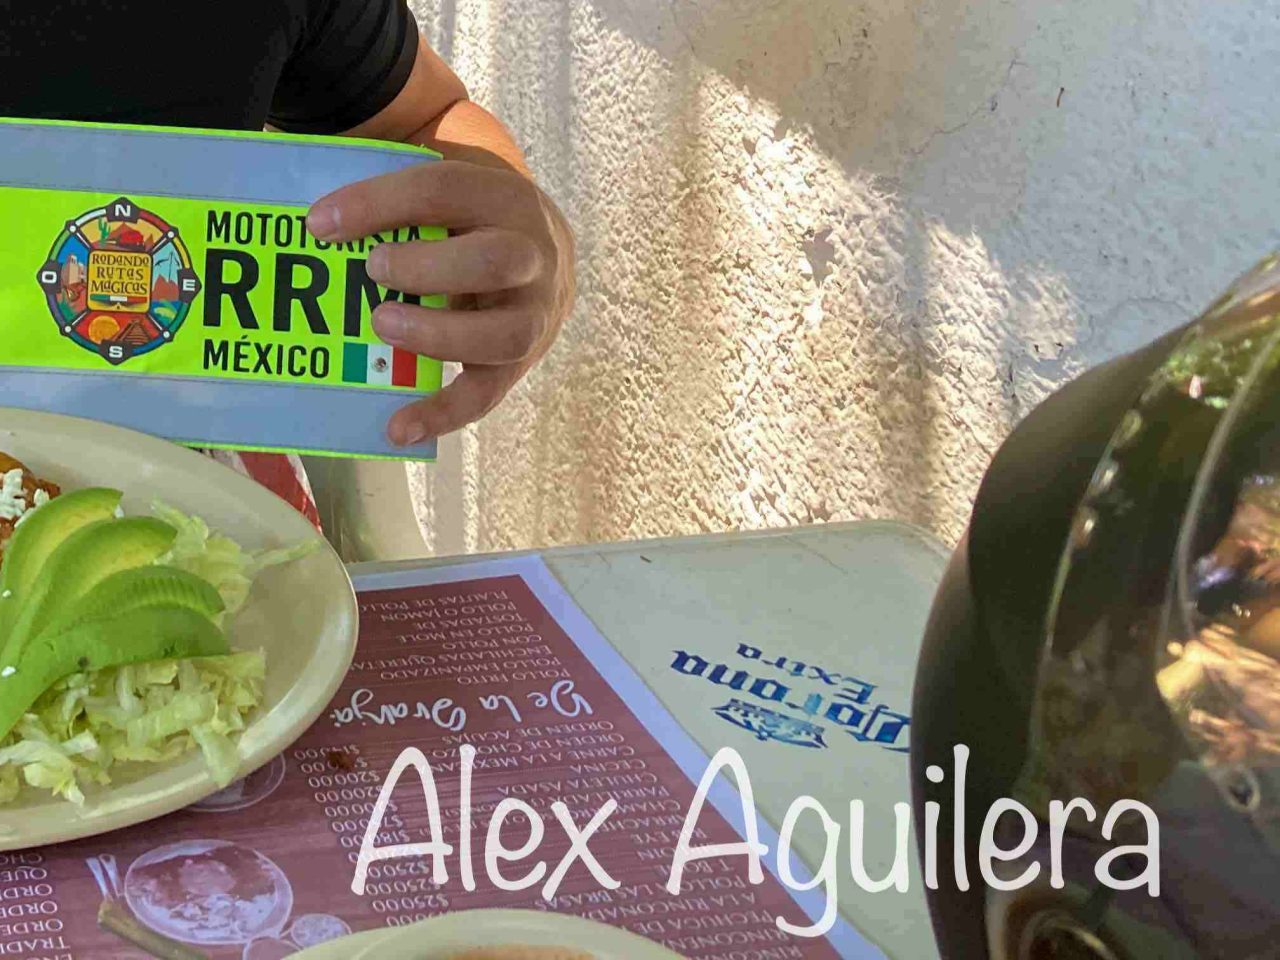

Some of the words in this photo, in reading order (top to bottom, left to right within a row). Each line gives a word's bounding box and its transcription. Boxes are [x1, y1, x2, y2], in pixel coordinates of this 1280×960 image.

[114, 204, 131, 218] N
[41, 271, 57, 284] O
[182, 278, 196, 292] E
[203, 247, 422, 338] RRM
[108, 345, 123, 359] S
[203, 334, 330, 379] MÉXICO
[460, 600, 517, 615] POLLO
[438, 611, 526, 628] TOSTADAS
[477, 622, 535, 637] POLLO
[441, 637, 499, 650] POLLO
[437, 643, 552, 663] ENCHILADAS
[346, 654, 436, 672] QUERETA
[503, 656, 561, 670] POLLO
[512, 667, 570, 682] POLLO
[736, 643, 879, 705] Extra
[527, 679, 592, 717] De
[671, 650, 911, 754] Corona
[478, 694, 521, 723] la
[515, 725, 540, 739] DE
[544, 718, 614, 736] ORDEN
[431, 740, 522, 758] CHOZO
[526, 738, 551, 751] DE
[554, 731, 625, 749] ORDEN
[566, 744, 635, 761] CARNE
[300, 756, 368, 774] $0.00
[424, 755, 517, 773] MEXICAN
[567, 758, 646, 774] CECINA
[308, 770, 380, 788] $200.00
[496, 779, 561, 796] ASADA
[565, 770, 658, 791] CHULETA
[324, 799, 398, 818] $00.00
[567, 798, 680, 820] CHAMRRO
[331, 814, 403, 833] $70.00
[577, 813, 686, 837] ARRACHE
[629, 830, 669, 846] EYE
[367, 861, 430, 879] $250.0
[534, 889, 613, 912] BRASAS
[615, 883, 654, 900] LAS
[372, 893, 449, 913] $250.00
[710, 895, 739, 907] LA
[632, 919, 665, 935] DE
[667, 909, 774, 931] PECHUGA
[660, 928, 790, 950] RINCONEN
